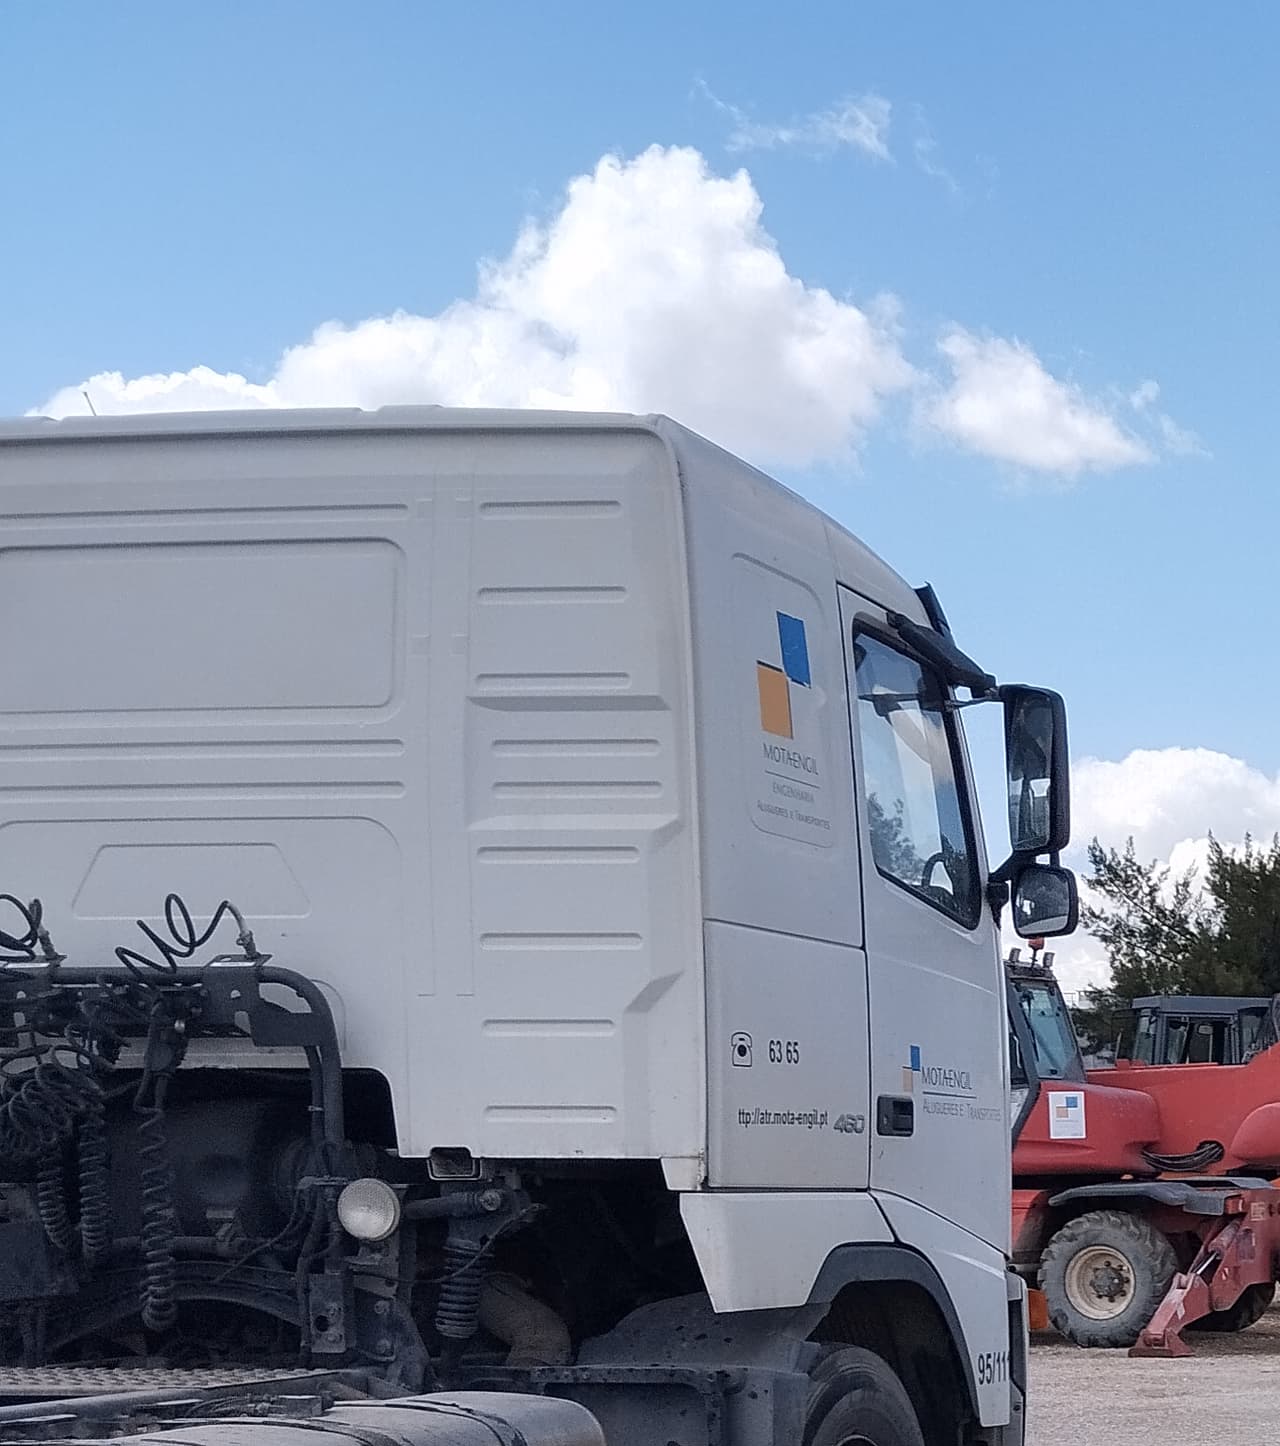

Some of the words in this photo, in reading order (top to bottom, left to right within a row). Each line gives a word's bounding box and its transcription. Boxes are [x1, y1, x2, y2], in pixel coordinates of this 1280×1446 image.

[769, 1040, 782, 1063] 63
[786, 1041, 800, 1064] 65
[833, 1113, 865, 1134] 460
